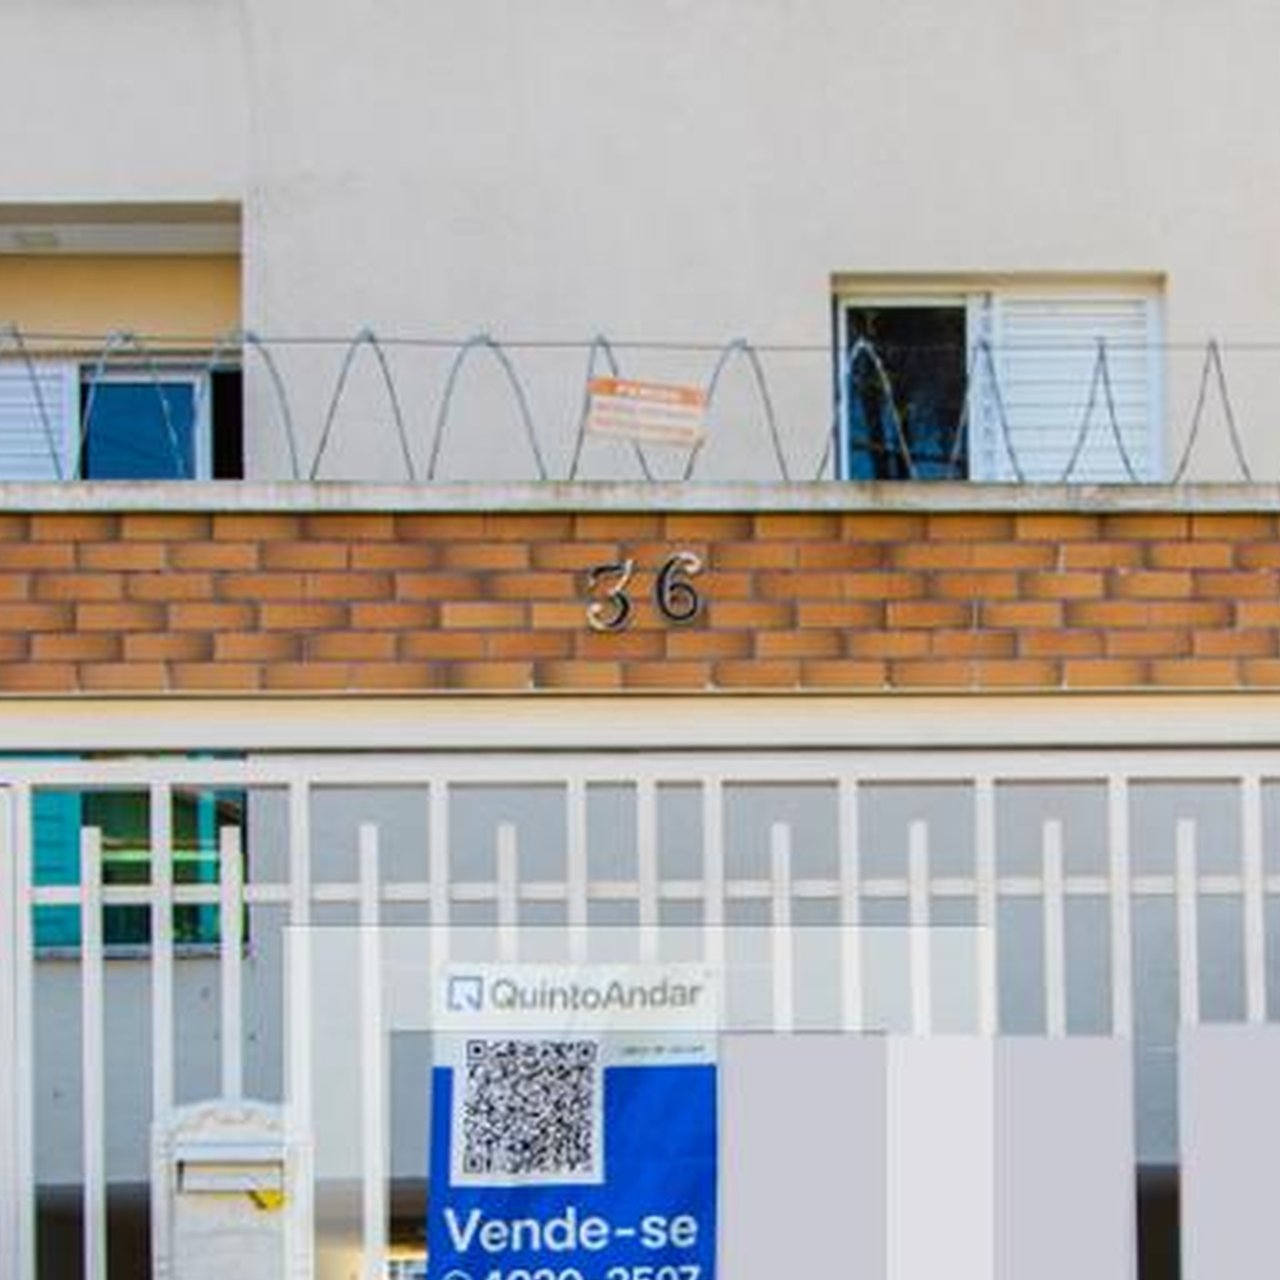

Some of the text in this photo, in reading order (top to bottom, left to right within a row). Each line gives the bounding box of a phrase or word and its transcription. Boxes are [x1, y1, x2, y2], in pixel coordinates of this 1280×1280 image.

[588, 552, 701, 629] 36
[491, 978, 703, 1010] QuintoAndar
[444, 1206, 698, 1252] Vende-se
